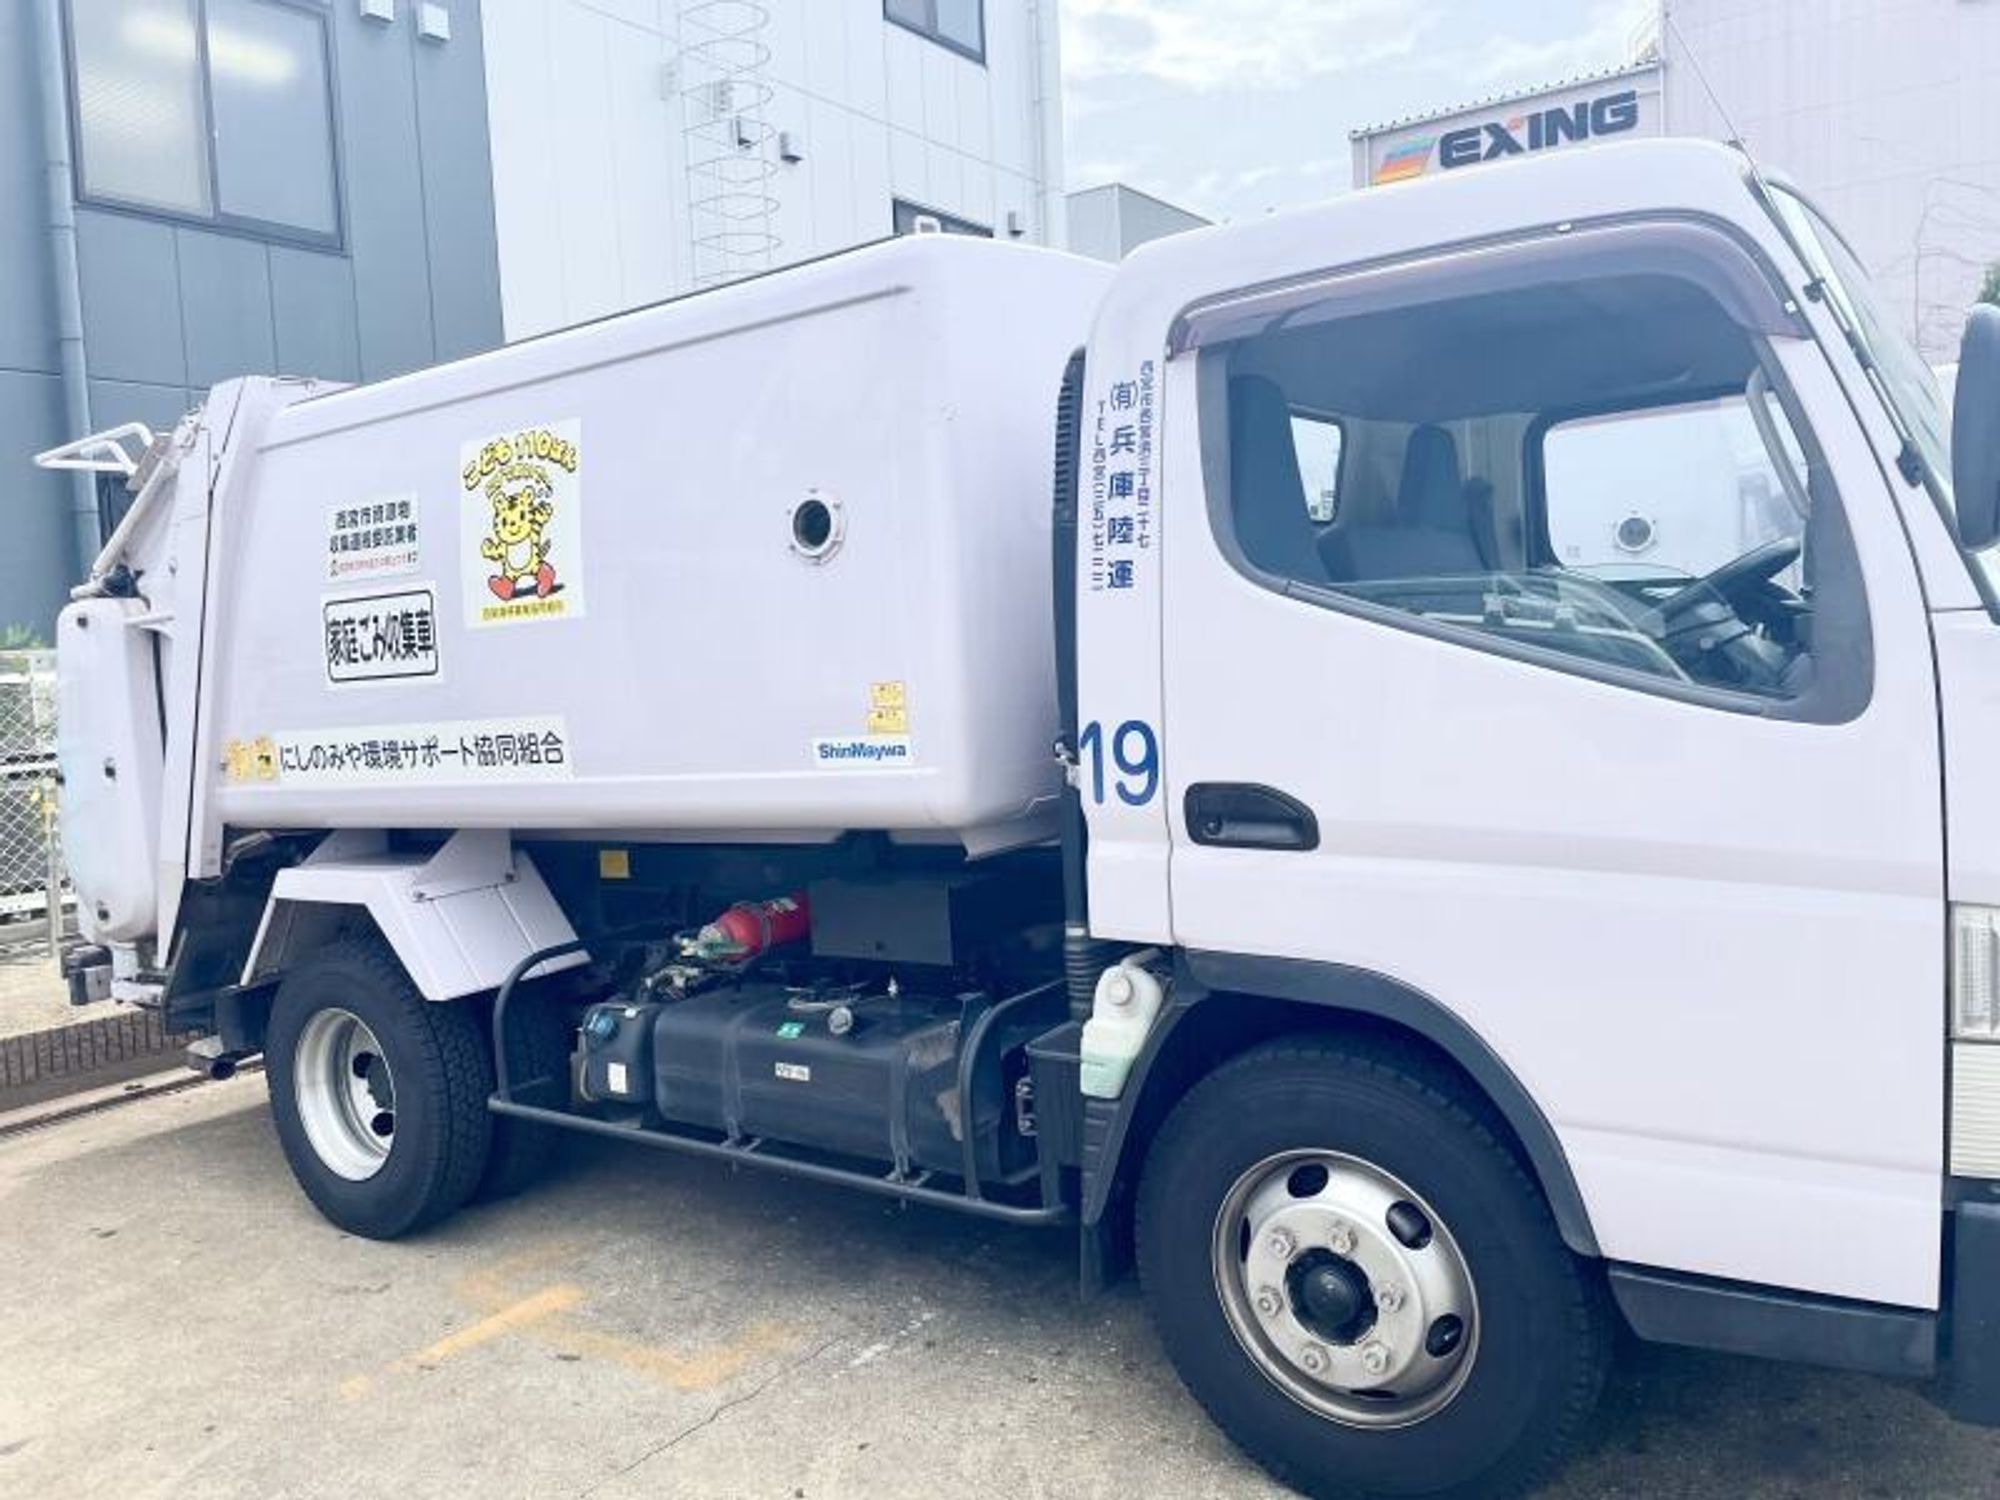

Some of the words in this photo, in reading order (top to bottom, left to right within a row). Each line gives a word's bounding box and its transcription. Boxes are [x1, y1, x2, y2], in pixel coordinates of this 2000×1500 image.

[1439, 90, 1638, 169] EXING
[328, 608, 433, 666] 家庭ごみ収集車
[279, 731, 564, 772] にしのみや環境サポート協同組合
[817, 742, 907, 761] ShinMaywa
[1080, 720, 1158, 806] 19
